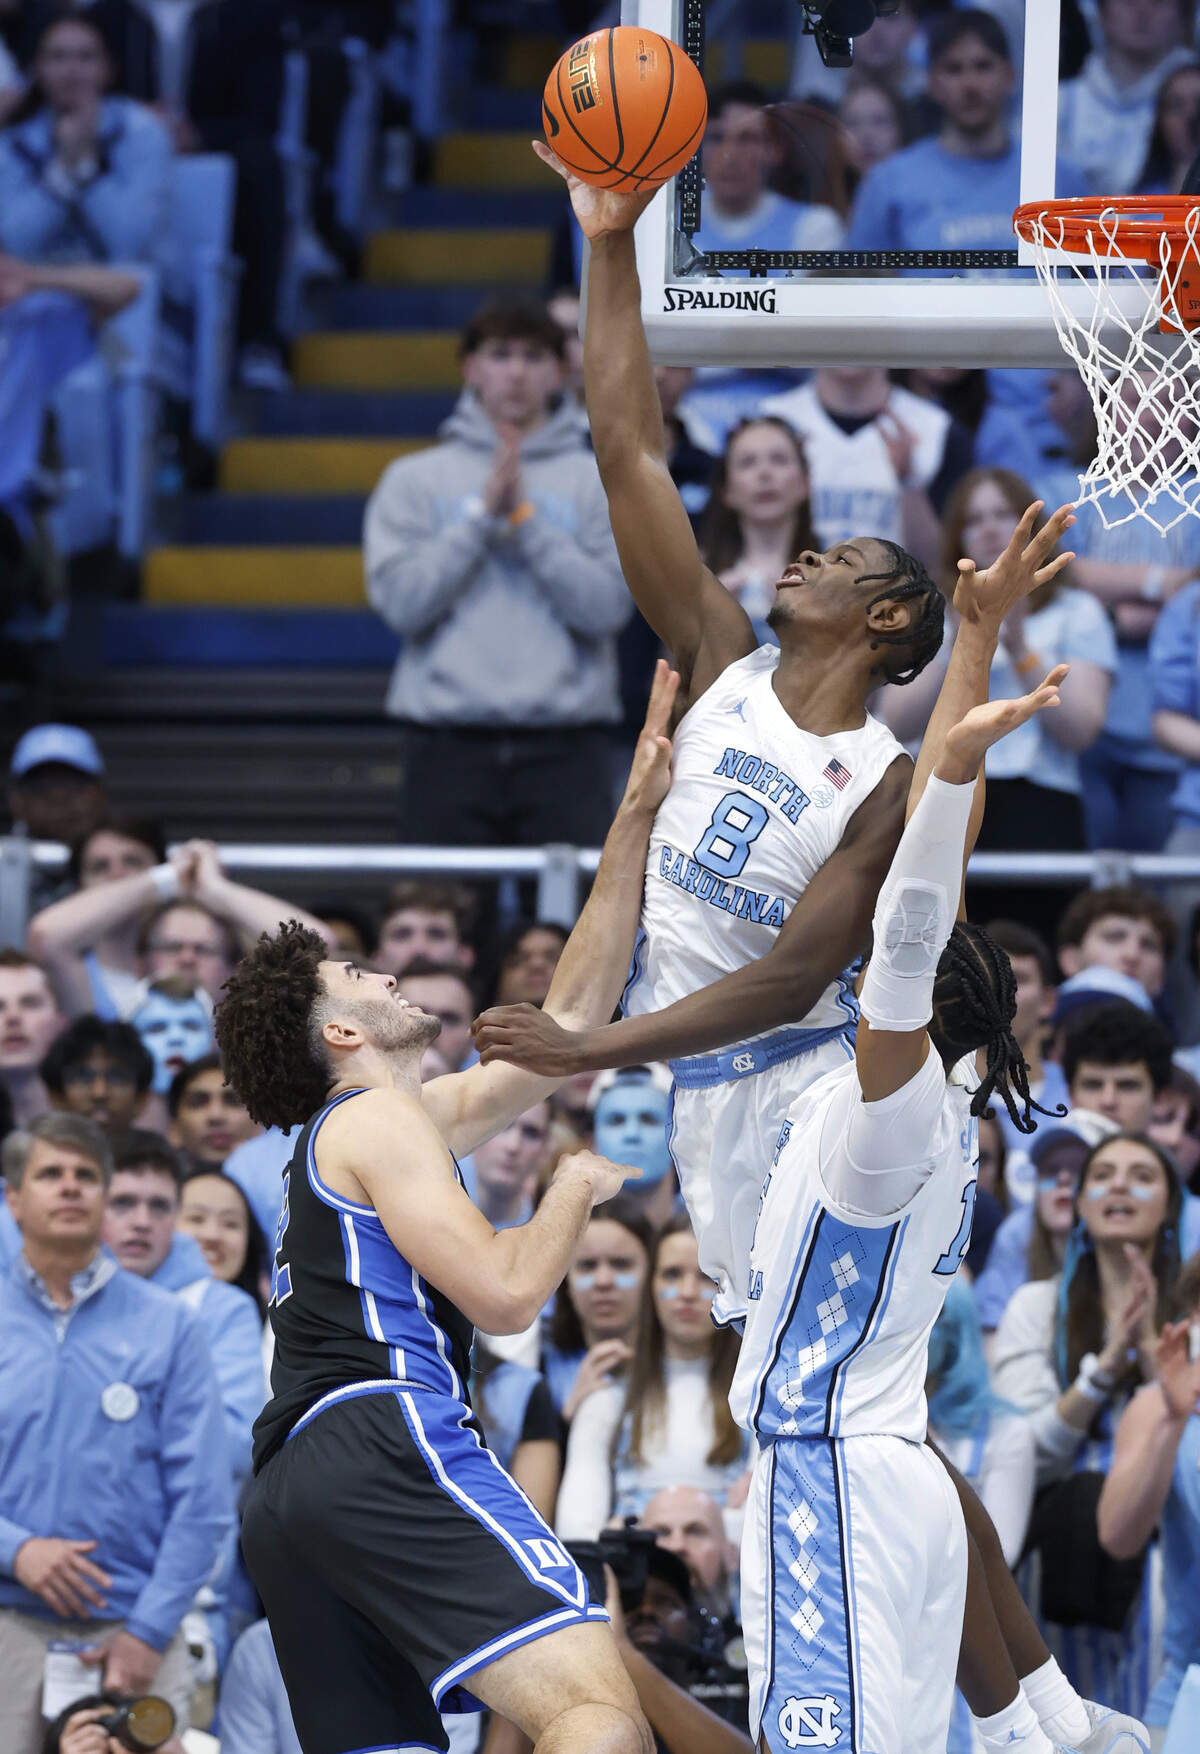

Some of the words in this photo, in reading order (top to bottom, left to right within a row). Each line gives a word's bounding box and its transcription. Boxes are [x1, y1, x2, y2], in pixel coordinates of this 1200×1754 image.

[569, 40, 596, 114] ELITE
[663, 287, 776, 314] SPALDING
[713, 747, 811, 825] NORTH
[693, 790, 770, 878] 8
[659, 845, 785, 928] CAROLINA
